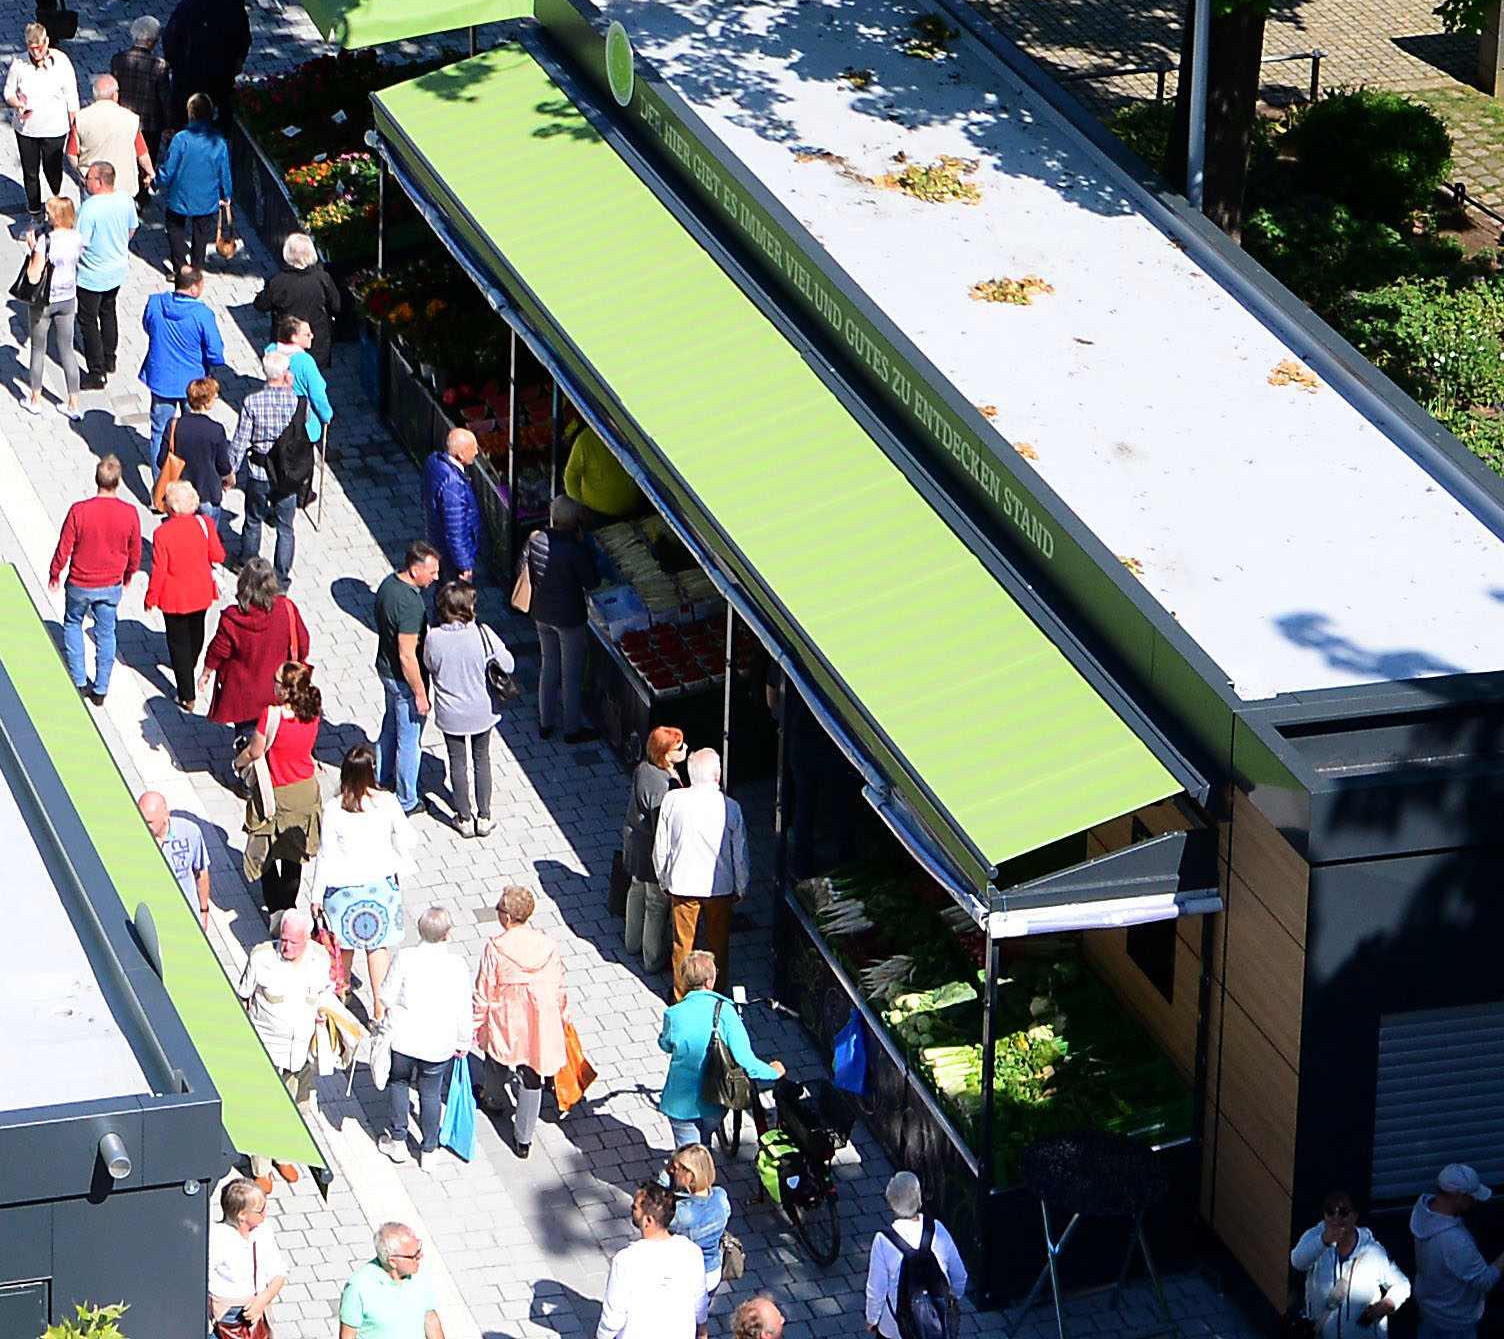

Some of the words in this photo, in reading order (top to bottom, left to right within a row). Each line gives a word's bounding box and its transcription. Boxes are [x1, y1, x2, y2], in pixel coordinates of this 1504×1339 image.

[664, 121, 691, 169] HIER
[693, 154, 721, 199] GIBT
[723, 184, 738, 219] ES
[740, 202, 784, 269] IMMER
[785, 251, 814, 302] VIEL
[814, 282, 842, 332] UND
[845, 318, 890, 384] GUTES
[892, 366, 911, 406] ZU
[914, 389, 1002, 504] ENTDECKEN
[1003, 486, 1055, 560] STAND
